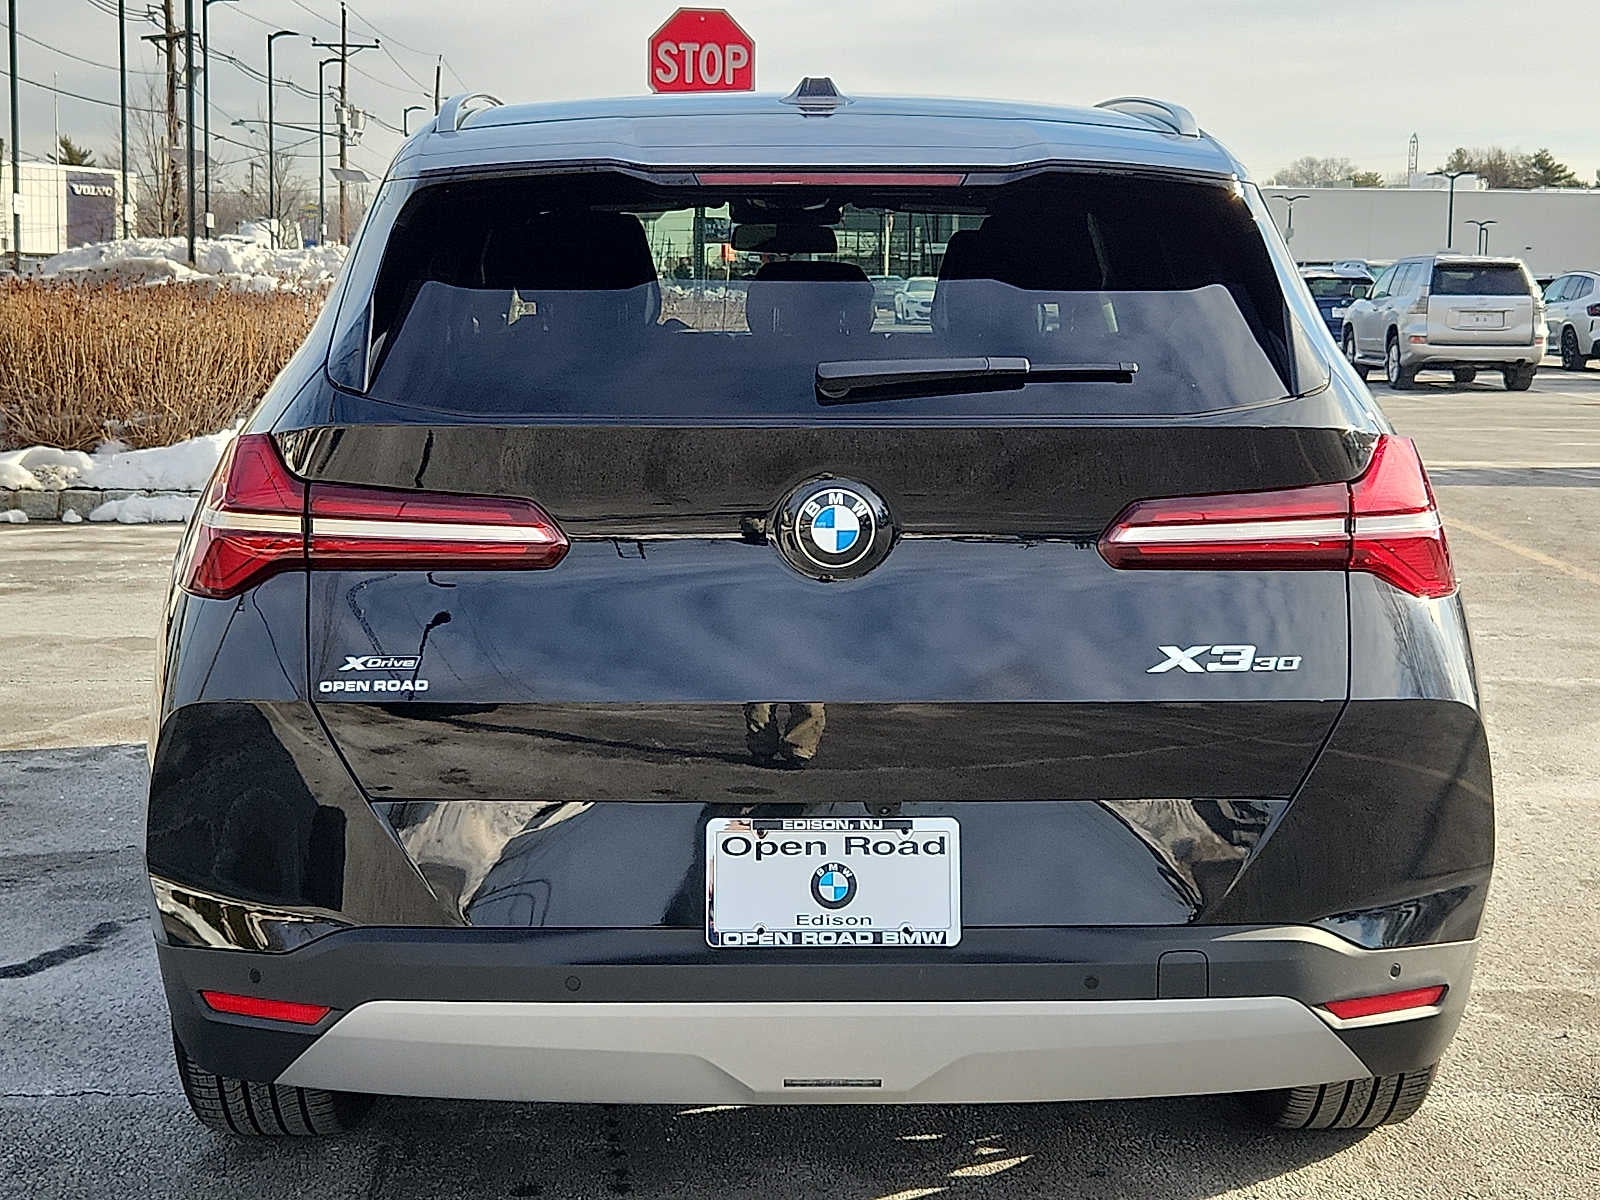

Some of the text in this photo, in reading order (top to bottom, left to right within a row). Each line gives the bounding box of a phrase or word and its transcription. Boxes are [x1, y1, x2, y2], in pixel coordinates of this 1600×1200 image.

[655, 41, 748, 85] STOP
[72, 183, 114, 197] VOLVO
[804, 492, 869, 518] BMW
[319, 680, 429, 693] OPEN ROAD
[782, 820, 884, 831] EDISON, NJ
[721, 836, 947, 861] Open Road
[816, 863, 853, 878] BMW
[796, 914, 873, 926] Edison
[723, 932, 945, 945] OPEN ROAD BMW
